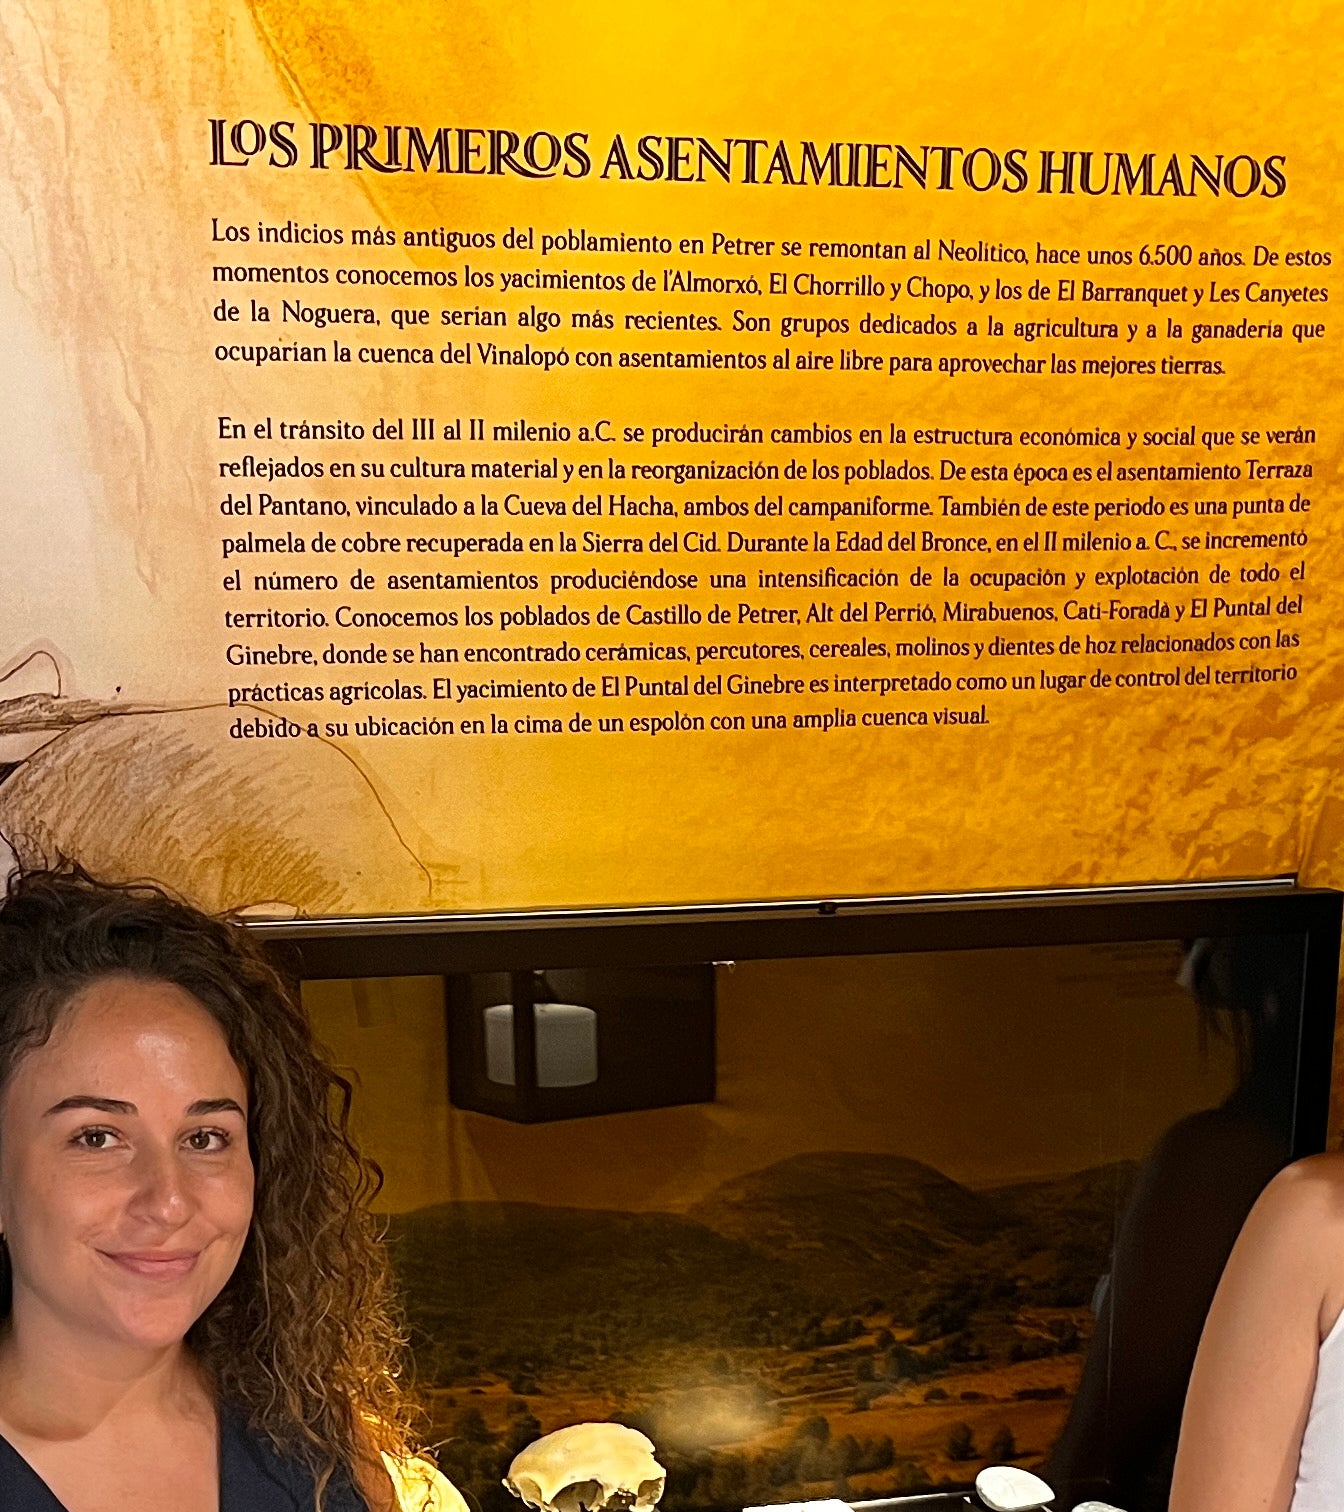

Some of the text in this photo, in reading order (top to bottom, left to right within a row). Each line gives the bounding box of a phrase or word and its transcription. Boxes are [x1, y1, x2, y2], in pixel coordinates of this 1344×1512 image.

[208, 118, 1287, 199] LOS PRIMEROS ASENTAMIENTOS HUMANOS
[211, 217, 251, 243] Los
[257, 219, 344, 245] indicios
[351, 224, 396, 247] más
[403, 226, 496, 254] antiguos
[502, 225, 534, 251] del
[541, 227, 673, 256] poblamiento
[679, 238, 704, 255] en
[711, 232, 776, 257] Petrer
[780, 240, 802, 258] se
[809, 241, 907, 261] remontan
[913, 238, 931, 261] al
[1035, 240, 1081, 265] hace
[1087, 249, 1133, 266] unos
[1138, 243, 1193, 267] 6.500
[1198, 247, 1246, 268] años.
[1253, 244, 1280, 267] De
[1284, 248, 1332, 268] estos
[212, 264, 1329, 308] momentos conocemos los yacimientos de l'Almorxó, El Chorrillo y Chopo, y los de El Barranquet y Les Canyetes
[333, 338, 352, 363] la
[357, 347, 435, 365] cuenca
[439, 341, 472, 365] del
[477, 341, 570, 372] Vinalopó
[575, 350, 613, 369] con
[618, 349, 767, 371] asentamientos
[772, 346, 790, 370] al
[795, 350, 834, 371] aire
[839, 348, 884, 371] libre
[888, 355, 933, 377] para
[938, 351, 1047, 379] aprovechar
[1050, 352, 1077, 375] las
[1081, 354, 1156, 379] mejores
[1161, 354, 1226, 376] tierras.
[218, 415, 1316, 452] En el tránsito del III al II milenio a.C. se producirán cambios en la estructura económica y social que se verán
